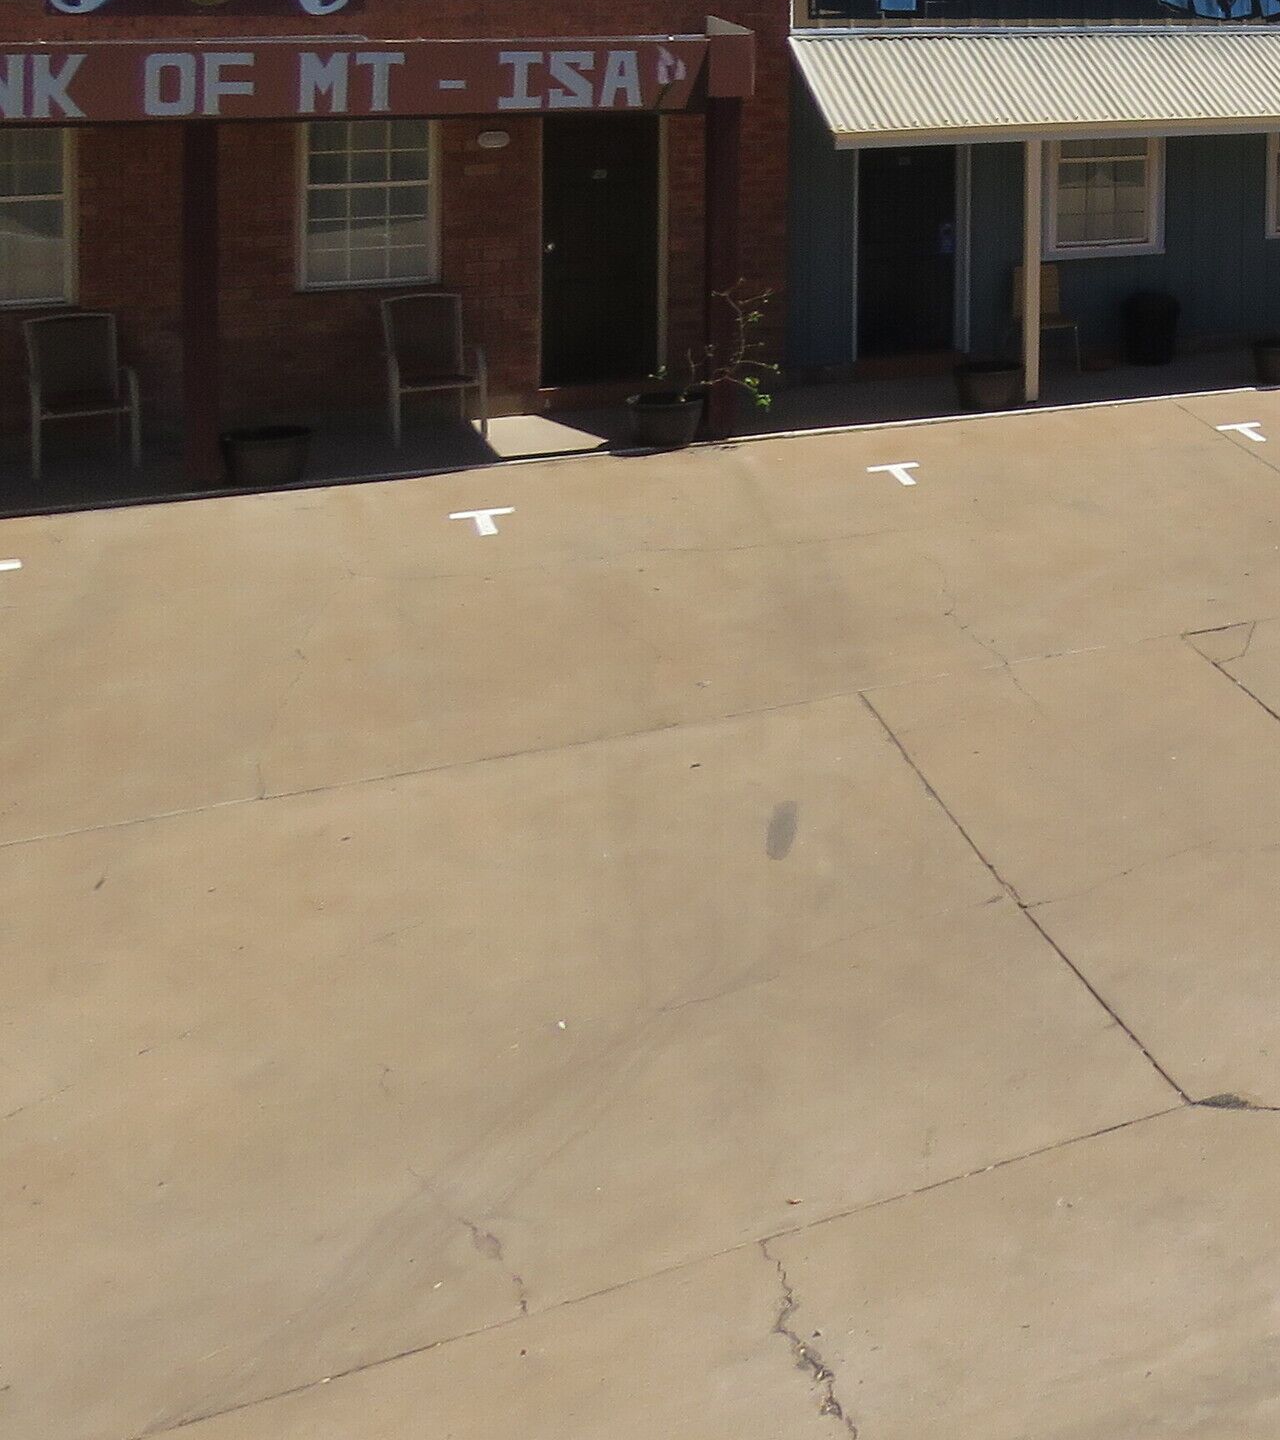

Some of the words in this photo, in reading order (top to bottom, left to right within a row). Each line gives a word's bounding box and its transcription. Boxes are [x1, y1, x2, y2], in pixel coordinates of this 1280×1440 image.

[144, 52, 254, 116] OF
[300, 52, 406, 114] MT
[498, 50, 642, 110] ISA
